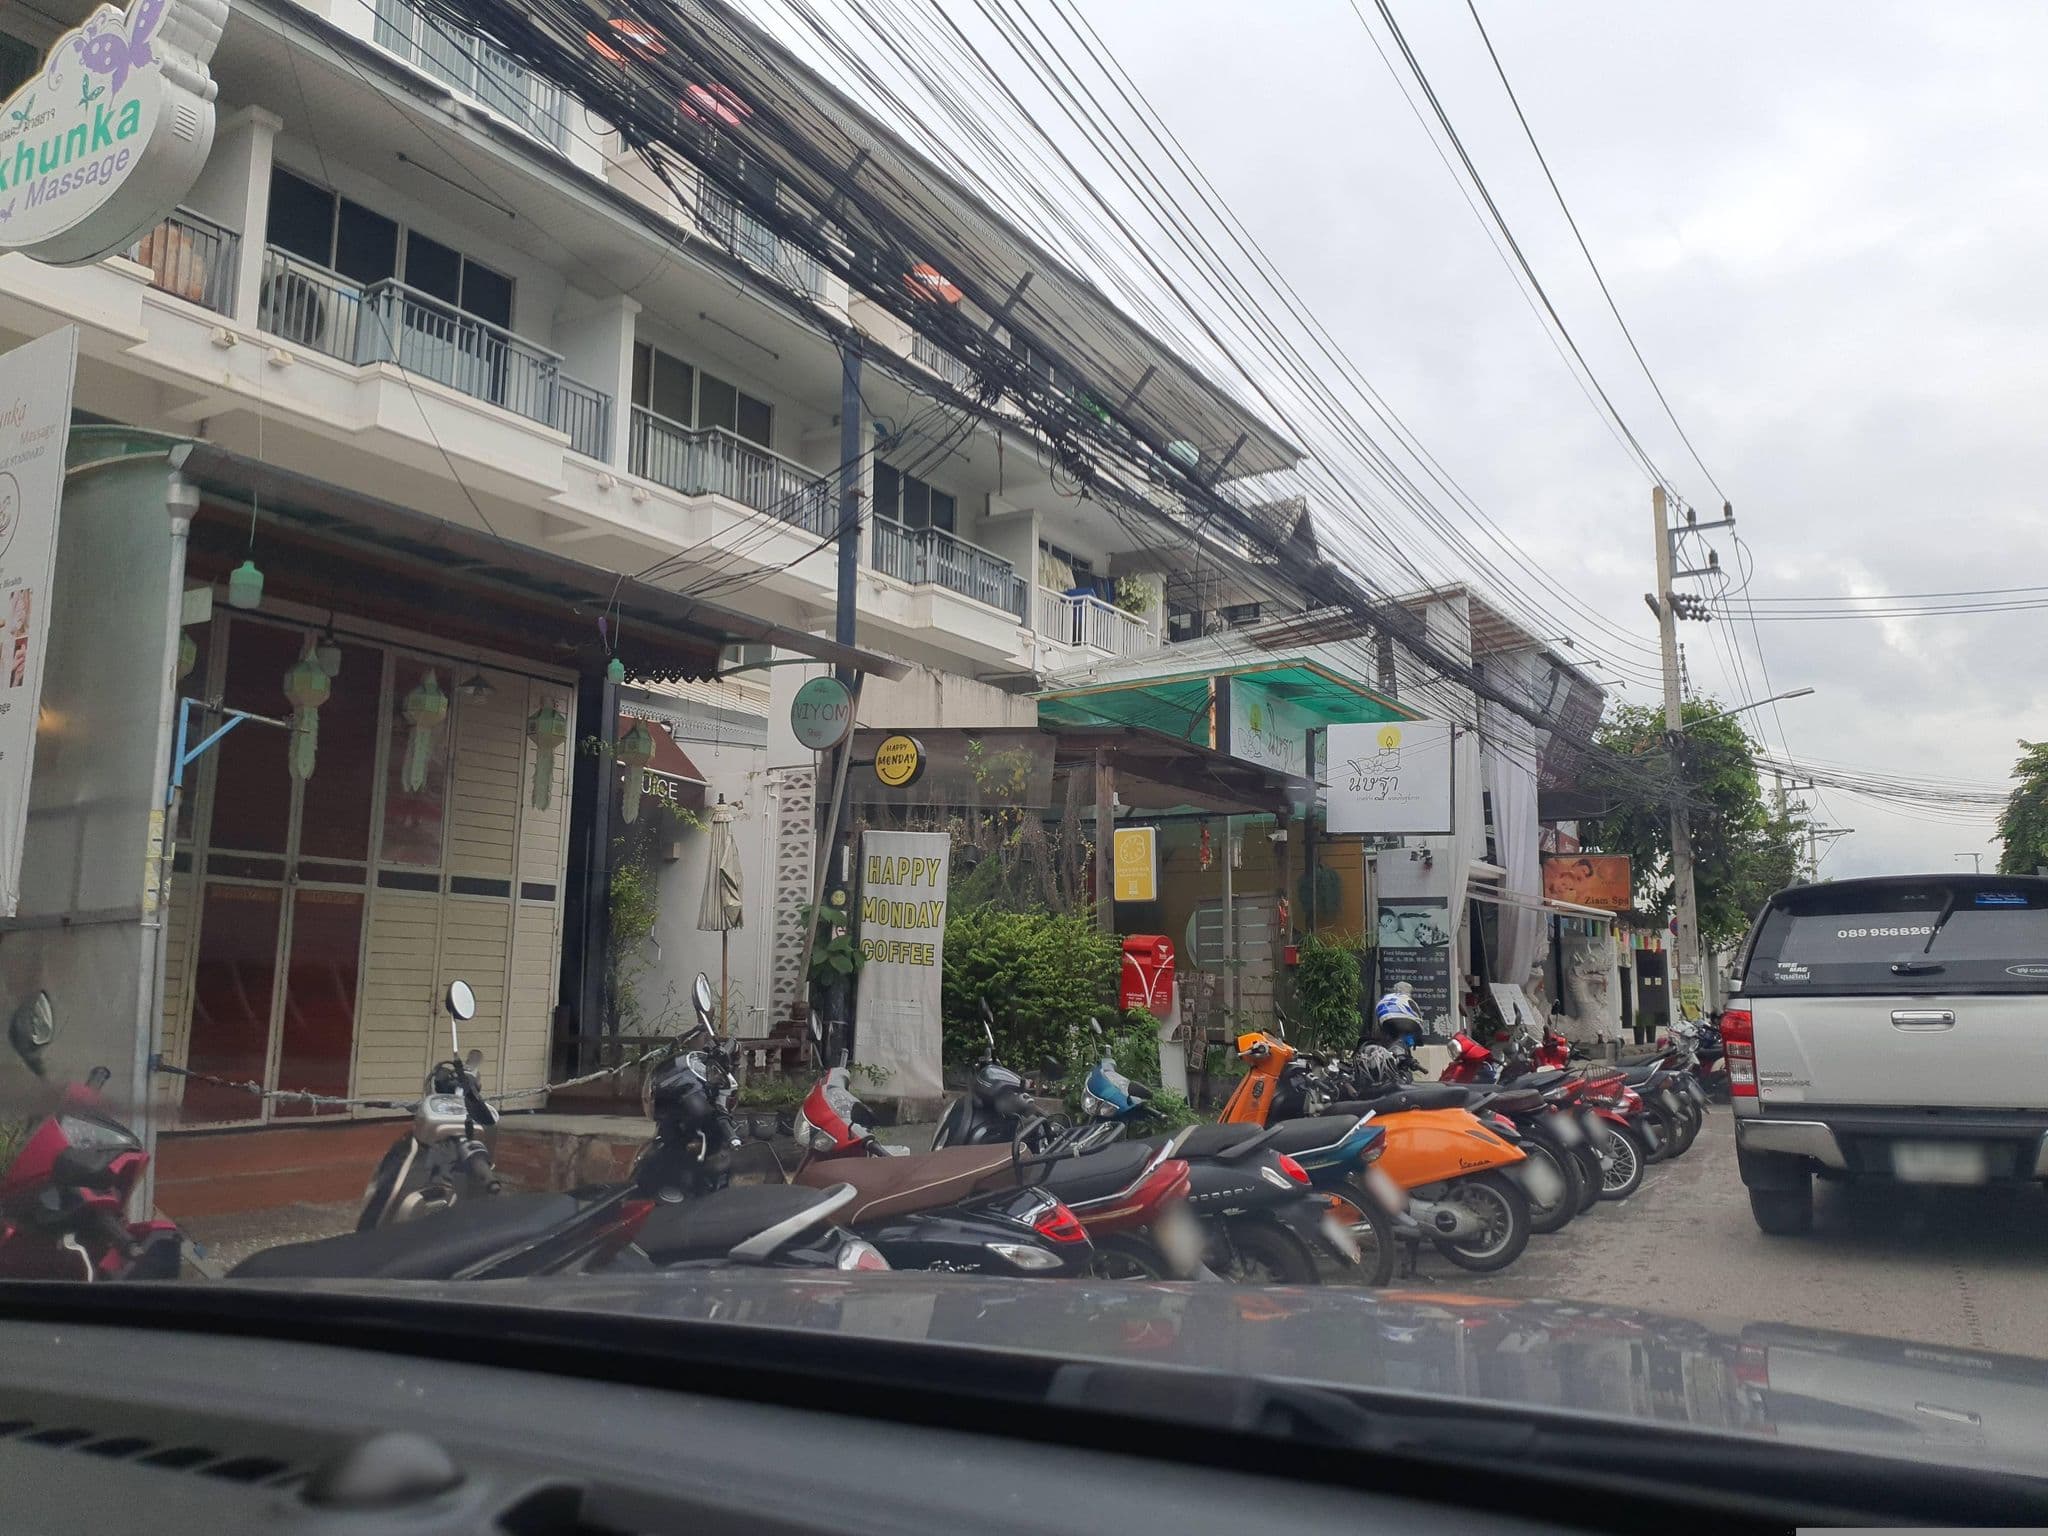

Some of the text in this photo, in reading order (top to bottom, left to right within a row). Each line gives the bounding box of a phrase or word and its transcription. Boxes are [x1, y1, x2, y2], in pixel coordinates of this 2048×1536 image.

[24, 148, 131, 211] Massage
[877, 753, 915, 765] MONDAY
[886, 743, 907, 752] HAPPY
[640, 773, 679, 800] UICE
[867, 855, 941, 887] HAPPY
[861, 895, 944, 929] MONDAY
[1838, 929, 1867, 938] 089
[861, 938, 935, 967] COFFEE
